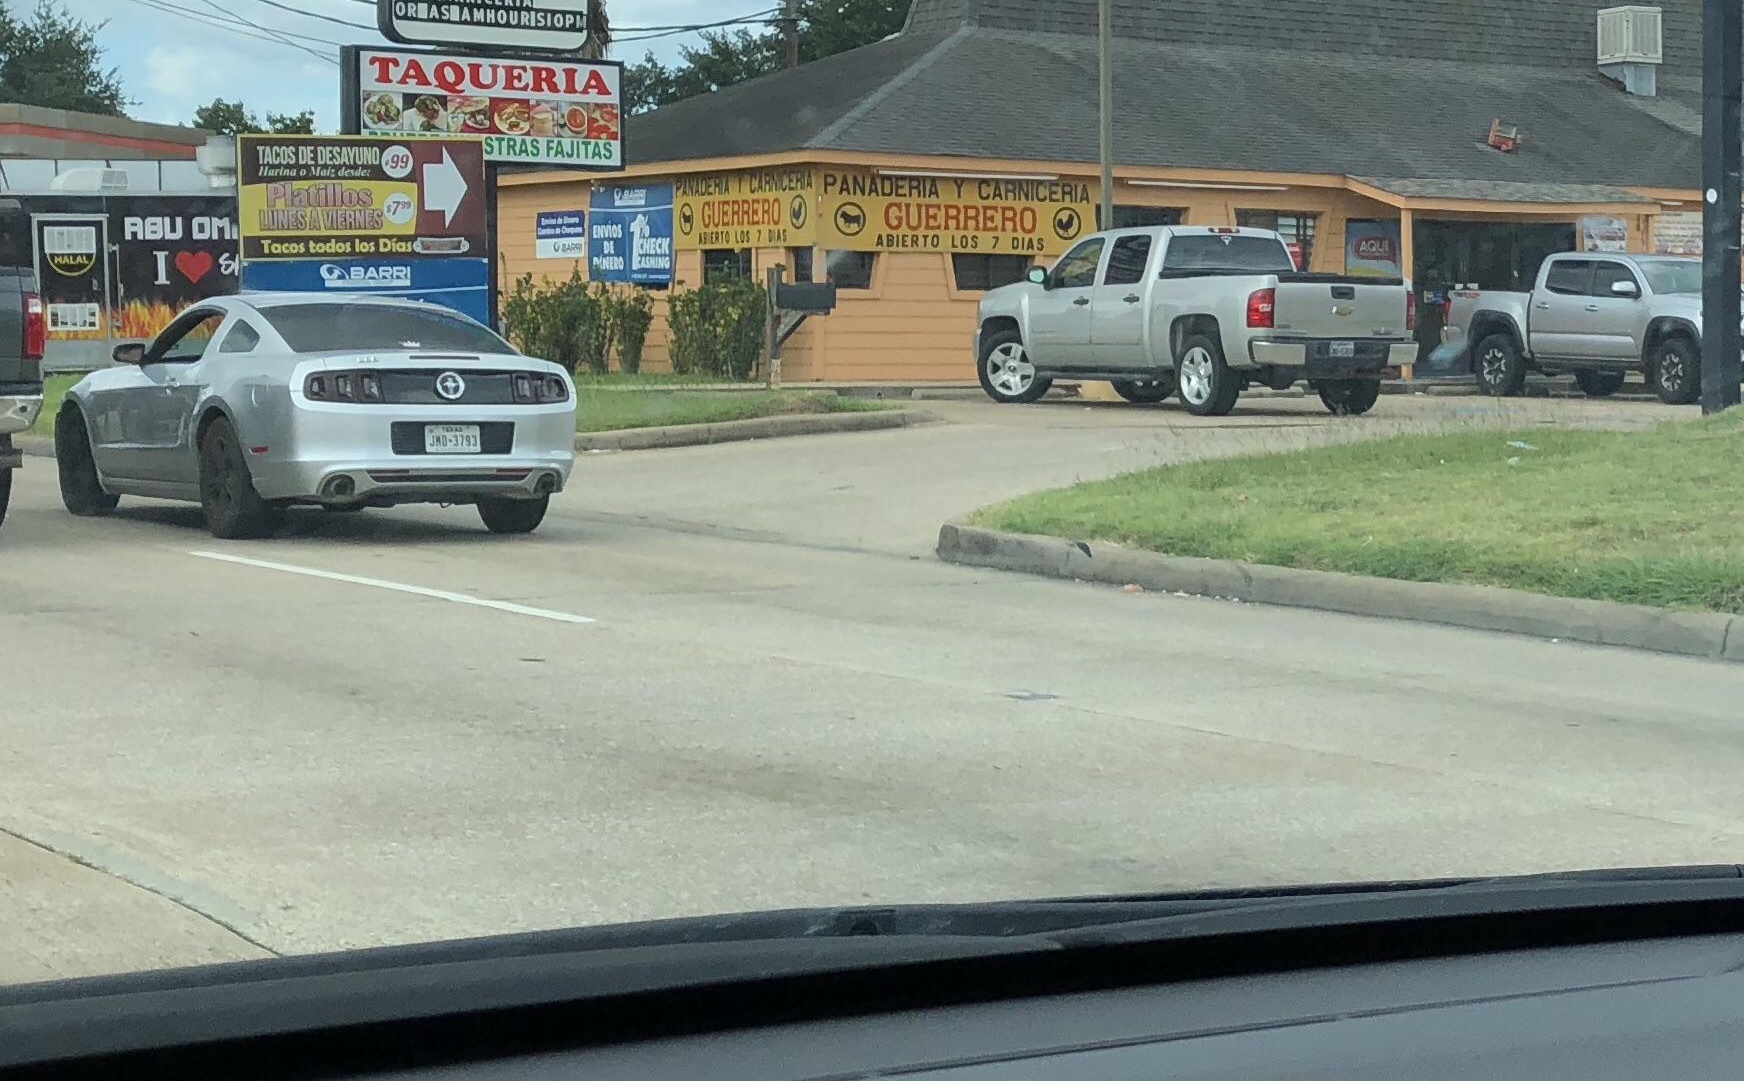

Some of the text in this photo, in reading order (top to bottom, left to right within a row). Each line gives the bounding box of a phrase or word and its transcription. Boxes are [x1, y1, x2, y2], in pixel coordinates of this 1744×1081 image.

[368, 55, 613, 96] TAQUERIA
[256, 145, 380, 166] TACOS DE DESAYUNO
[483, 135, 614, 160] STRAS FAJITAS
[258, 166, 297, 177] Harina
[266, 182, 373, 208] Platillos
[675, 174, 730, 198] PANADERIA
[823, 173, 1091, 204] PANADERIA Y CARNICERIA
[258, 208, 384, 231] LUNES A VIERNES
[701, 197, 781, 229] GUERRERO
[883, 201, 1038, 234] GUERRERO
[124, 216, 183, 240] ABU
[698, 228, 788, 245] ABIERTO LOS 7 DIAS
[260, 237, 413, 254] Tacos todos los Días
[603, 240, 615, 254] DE
[875, 234, 1045, 252] ABIERTO LOS 7 DIAS
[152, 250, 239, 285] I S
[350, 265, 411, 279] BARRI
